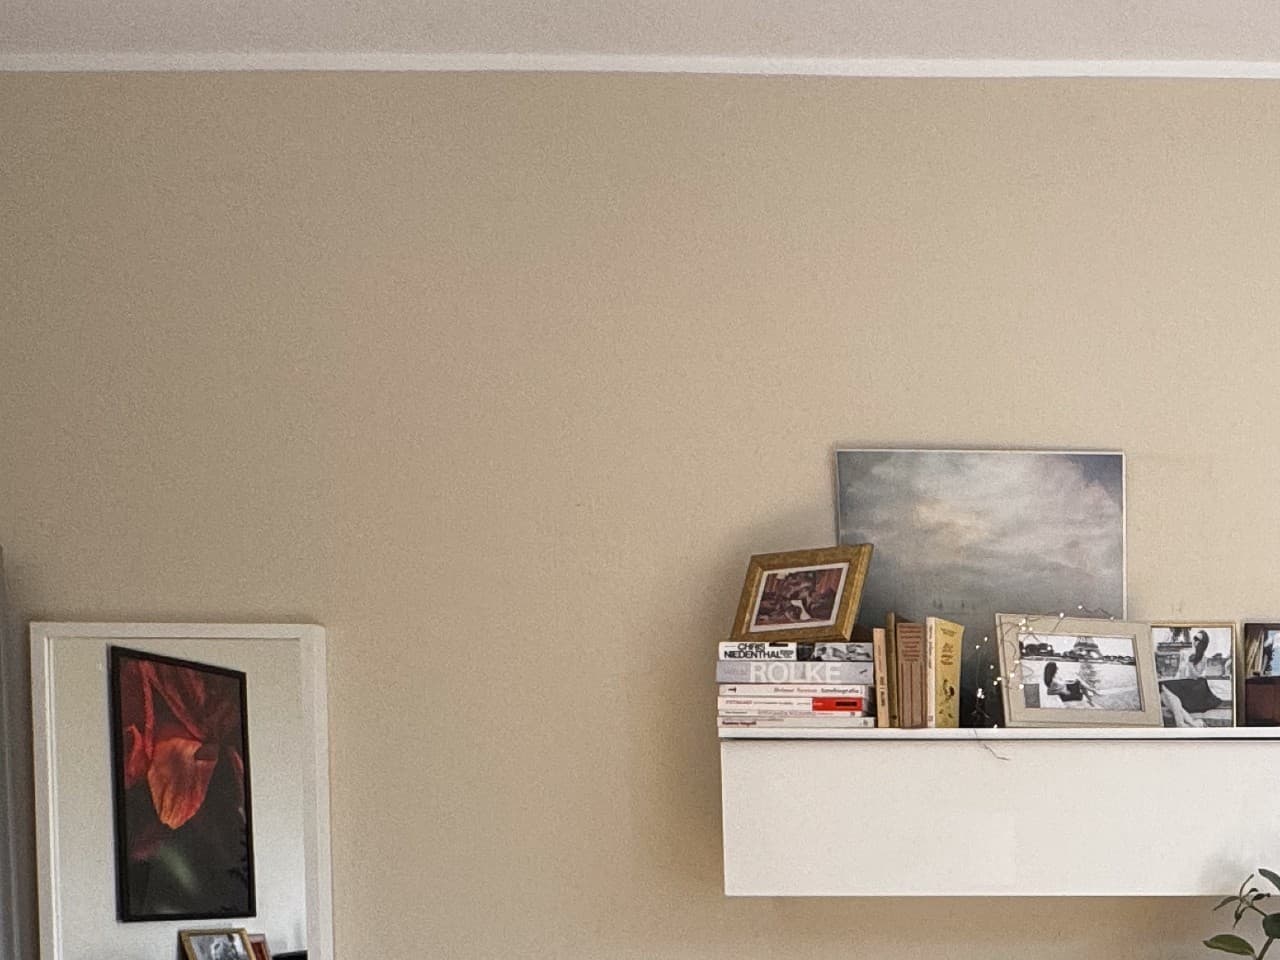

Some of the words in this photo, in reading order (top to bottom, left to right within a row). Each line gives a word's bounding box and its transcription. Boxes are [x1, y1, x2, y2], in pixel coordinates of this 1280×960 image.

[737, 642, 766, 650] CHRIS
[724, 650, 781, 659] NIEDENTHAL
[750, 661, 842, 682] ROLKE
